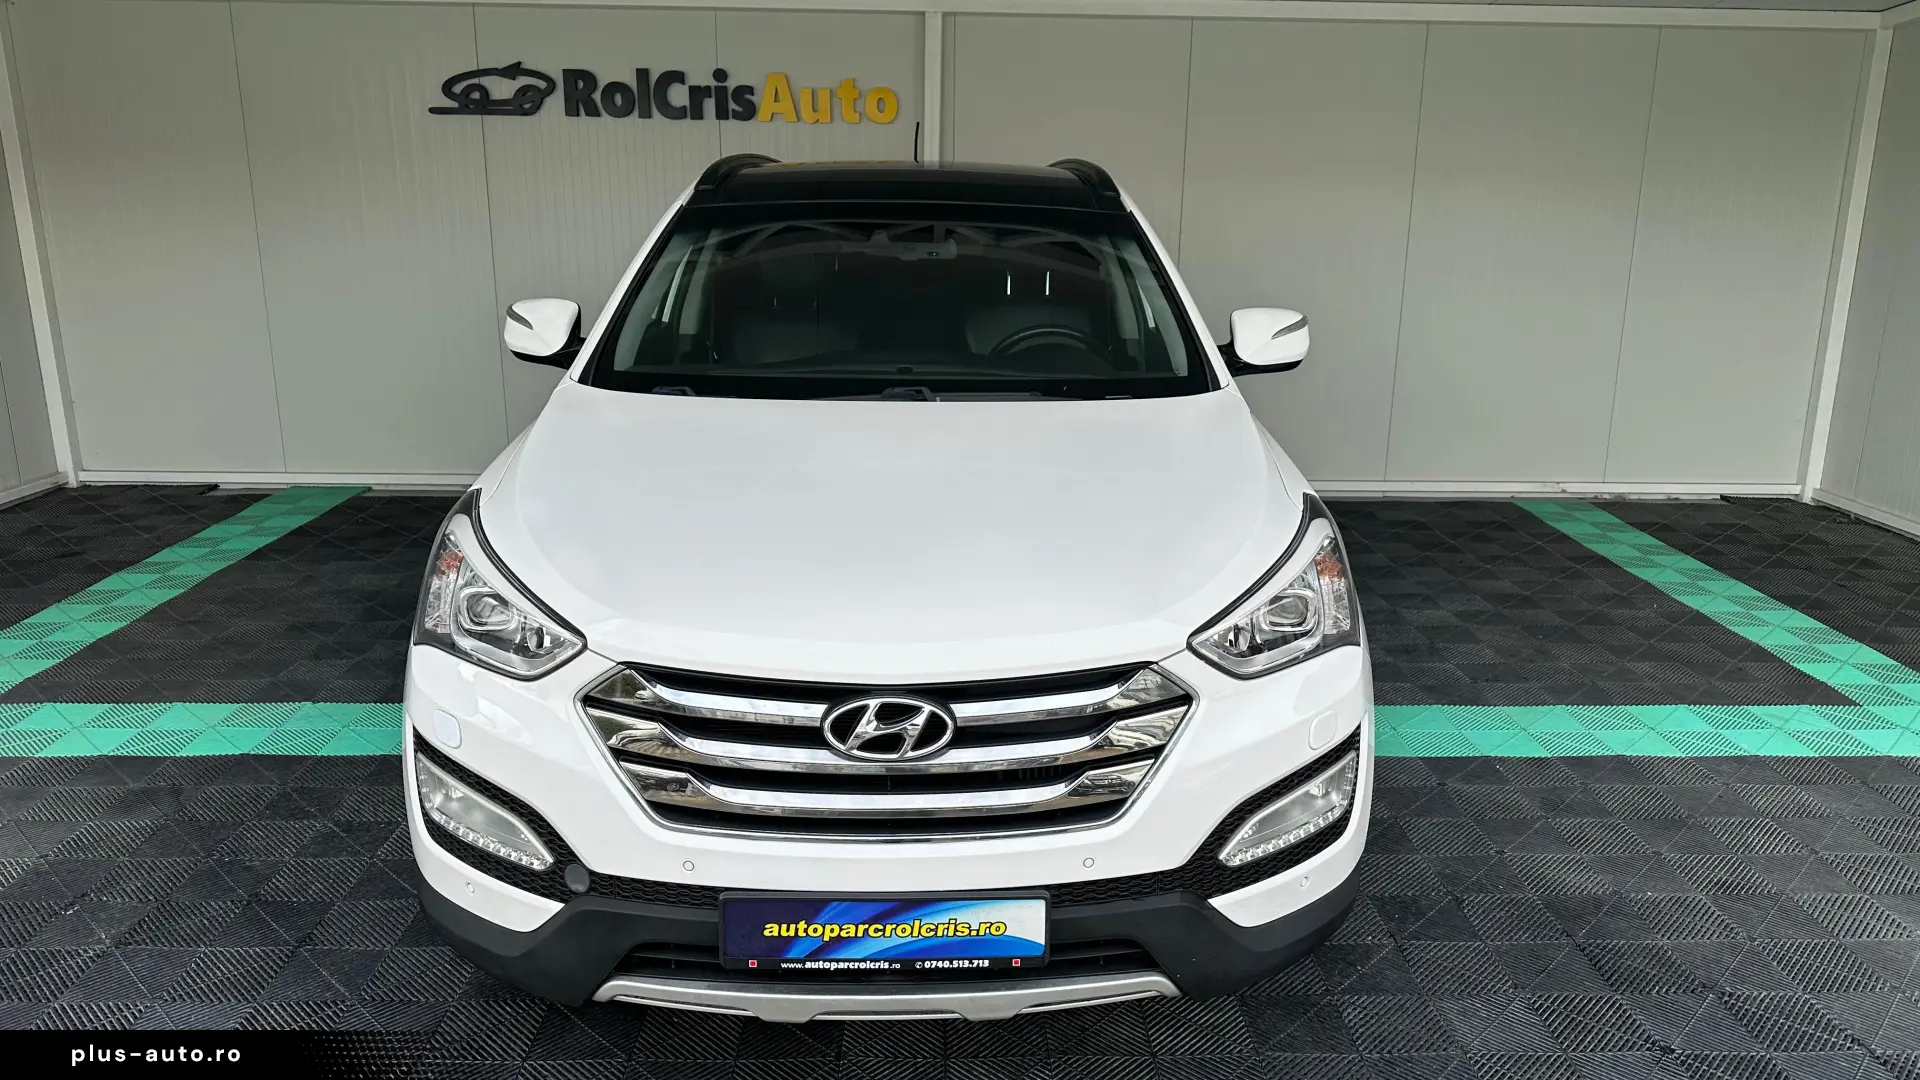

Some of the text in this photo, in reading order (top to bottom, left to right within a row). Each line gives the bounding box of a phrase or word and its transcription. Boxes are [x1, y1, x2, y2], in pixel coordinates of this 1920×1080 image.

[561, 67, 899, 124] RolCrisAuto
[763, 918, 1007, 942] autoparcrolcris.ro
[924, 959, 990, 969] 0740.513.713
